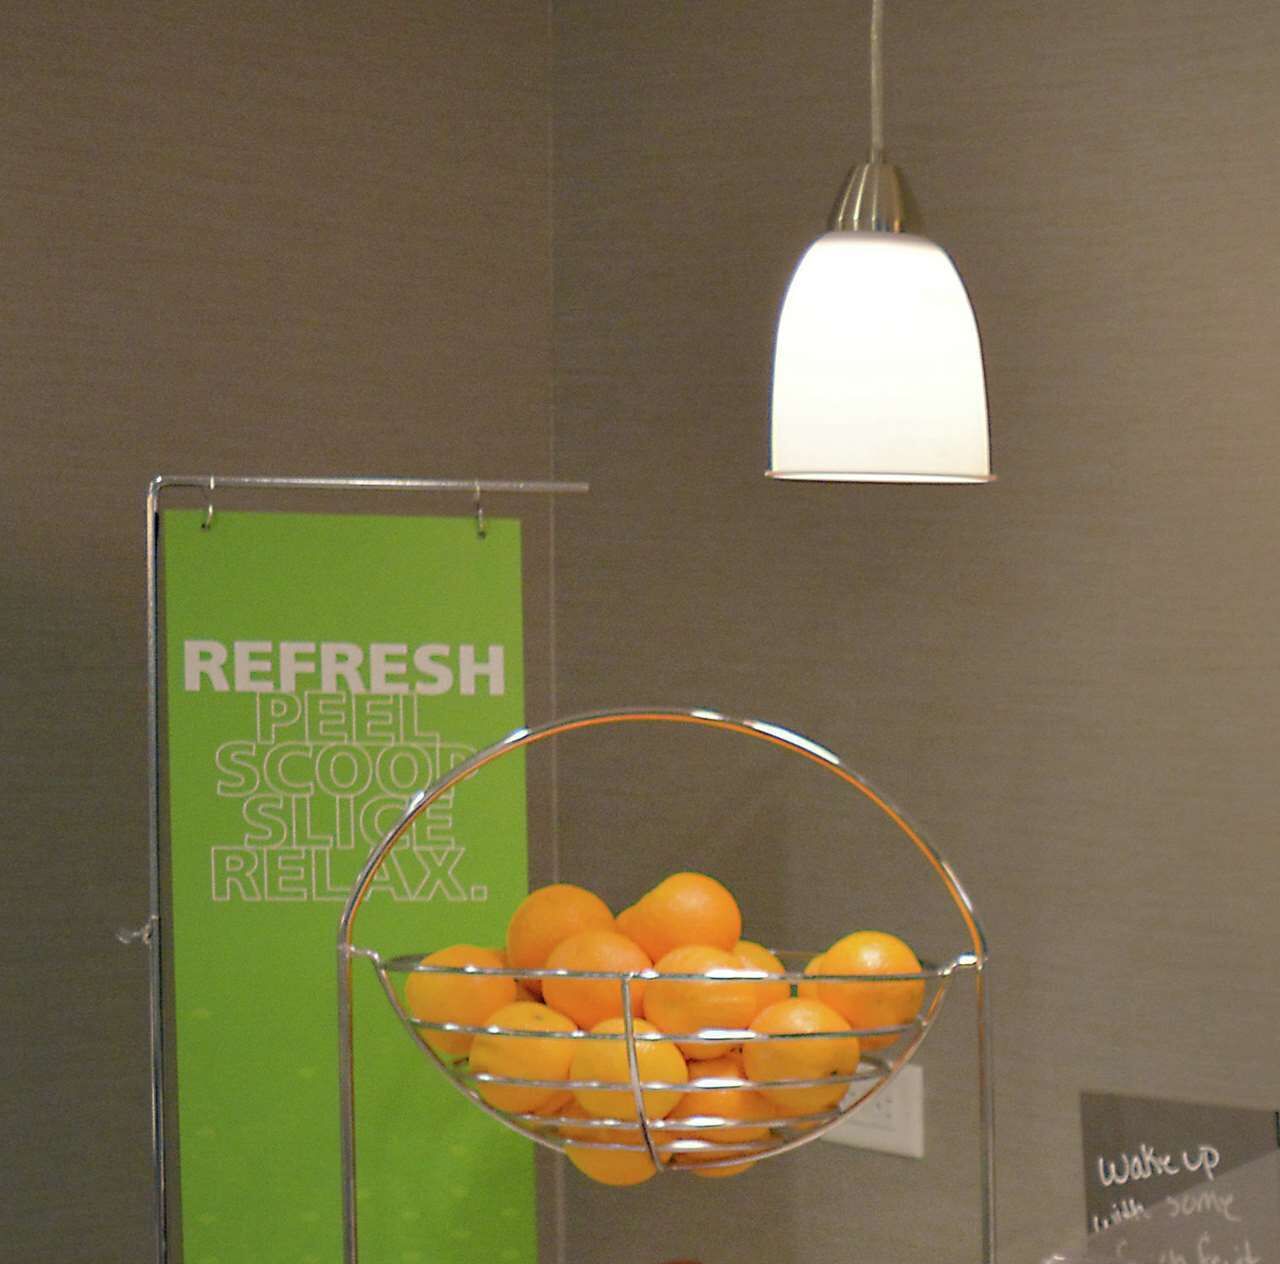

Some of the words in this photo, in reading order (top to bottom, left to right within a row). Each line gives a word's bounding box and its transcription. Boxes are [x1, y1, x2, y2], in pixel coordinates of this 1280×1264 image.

[183, 639, 505, 696] REFRESH
[255, 692, 440, 745] PEEL
[242, 793, 454, 850] SLICE
[210, 846, 488, 903] RELAX.
[1098, 1143, 1180, 1187] Wake
[1182, 1145, 1220, 1181] up
[1164, 1190, 1242, 1222] some
